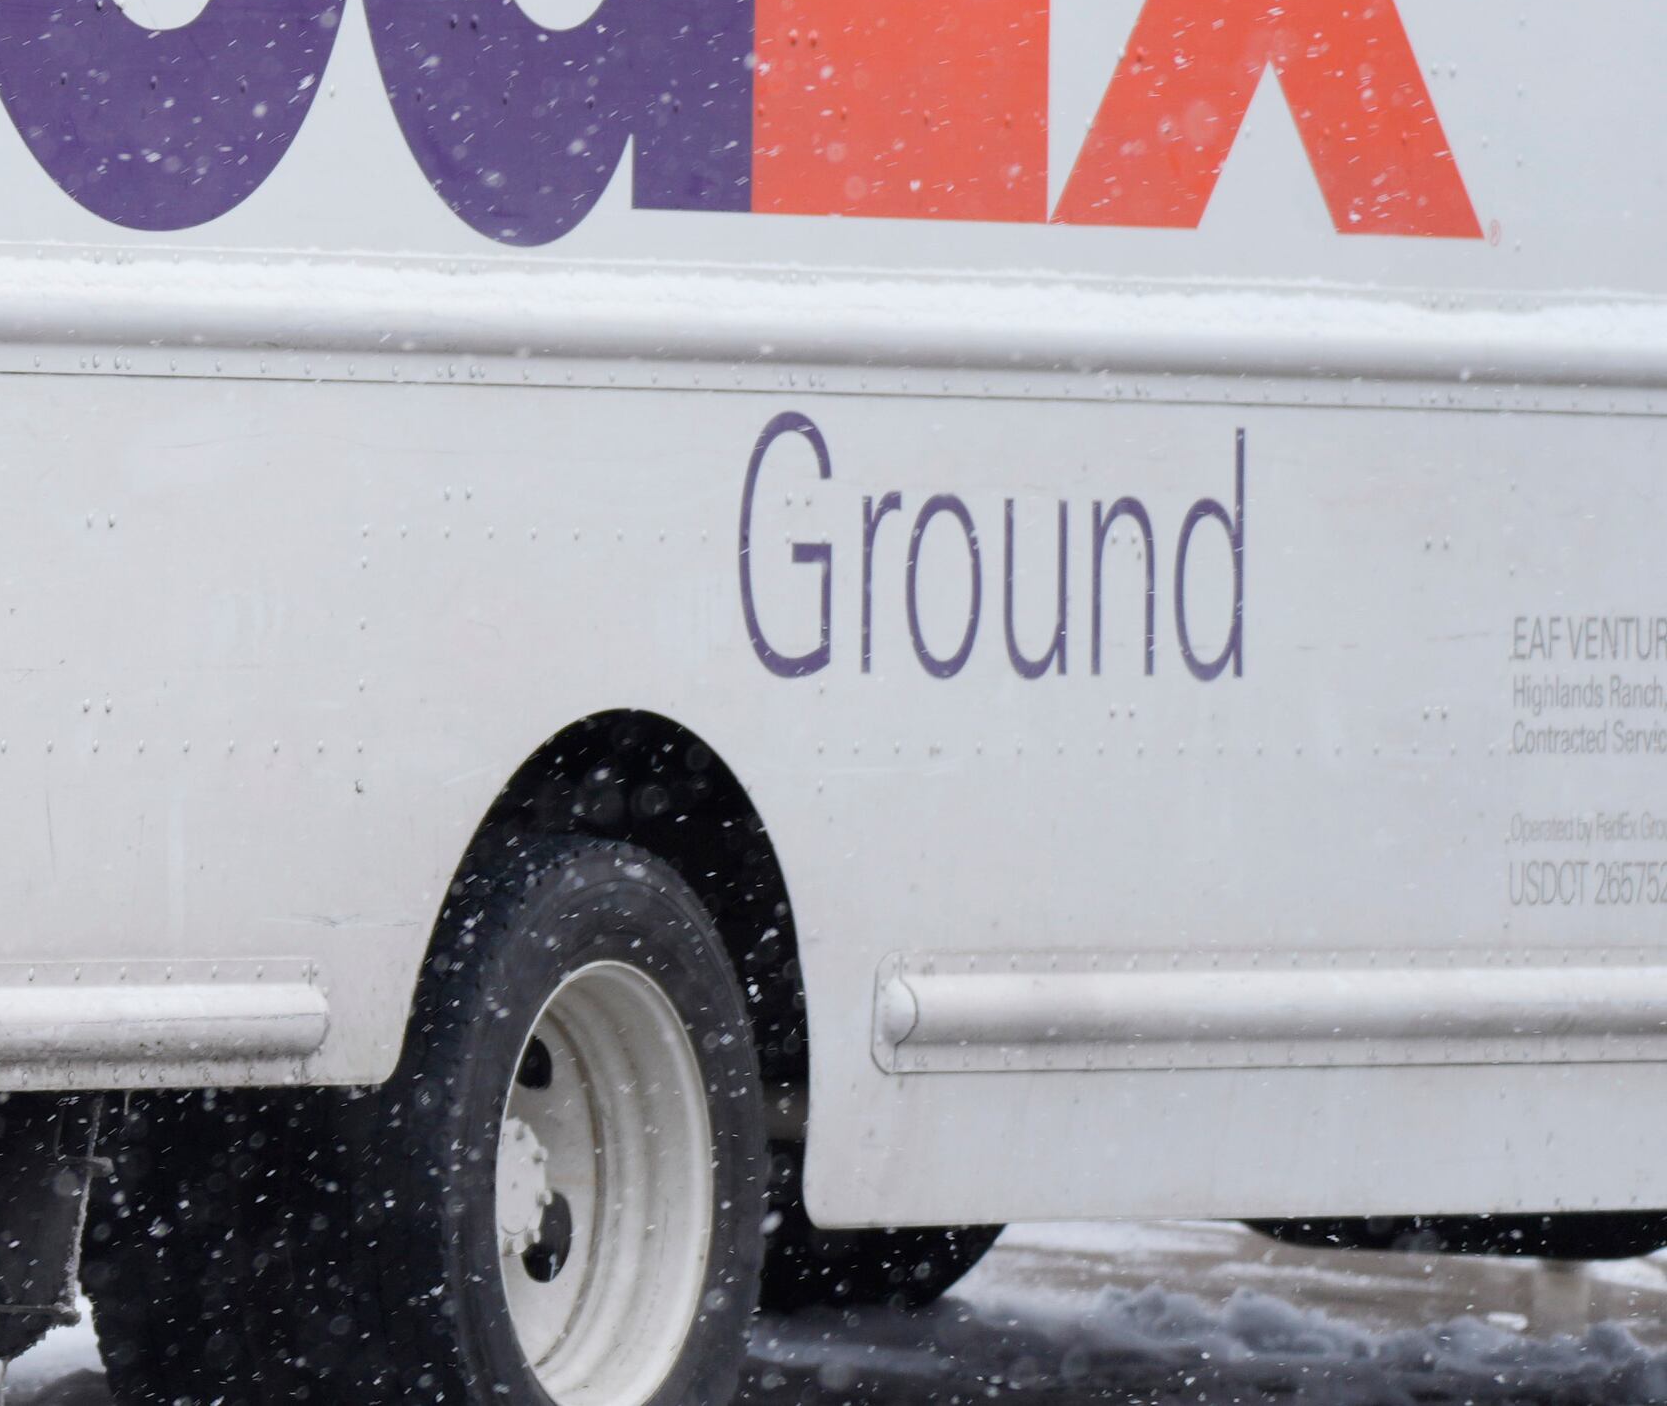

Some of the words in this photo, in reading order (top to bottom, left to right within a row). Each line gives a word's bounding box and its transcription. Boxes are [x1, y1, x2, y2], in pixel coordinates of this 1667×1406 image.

[738, 410, 1246, 682] Ground
[1513, 616, 1561, 660] EAF
[1567, 616, 1667, 661] VENTUR
[1512, 674, 1604, 717] Highlands
[1511, 719, 1607, 755] Contracted
[1510, 811, 1573, 846] Operated
[1577, 814, 1593, 846] by
[1596, 811, 1636, 841] FedEx
